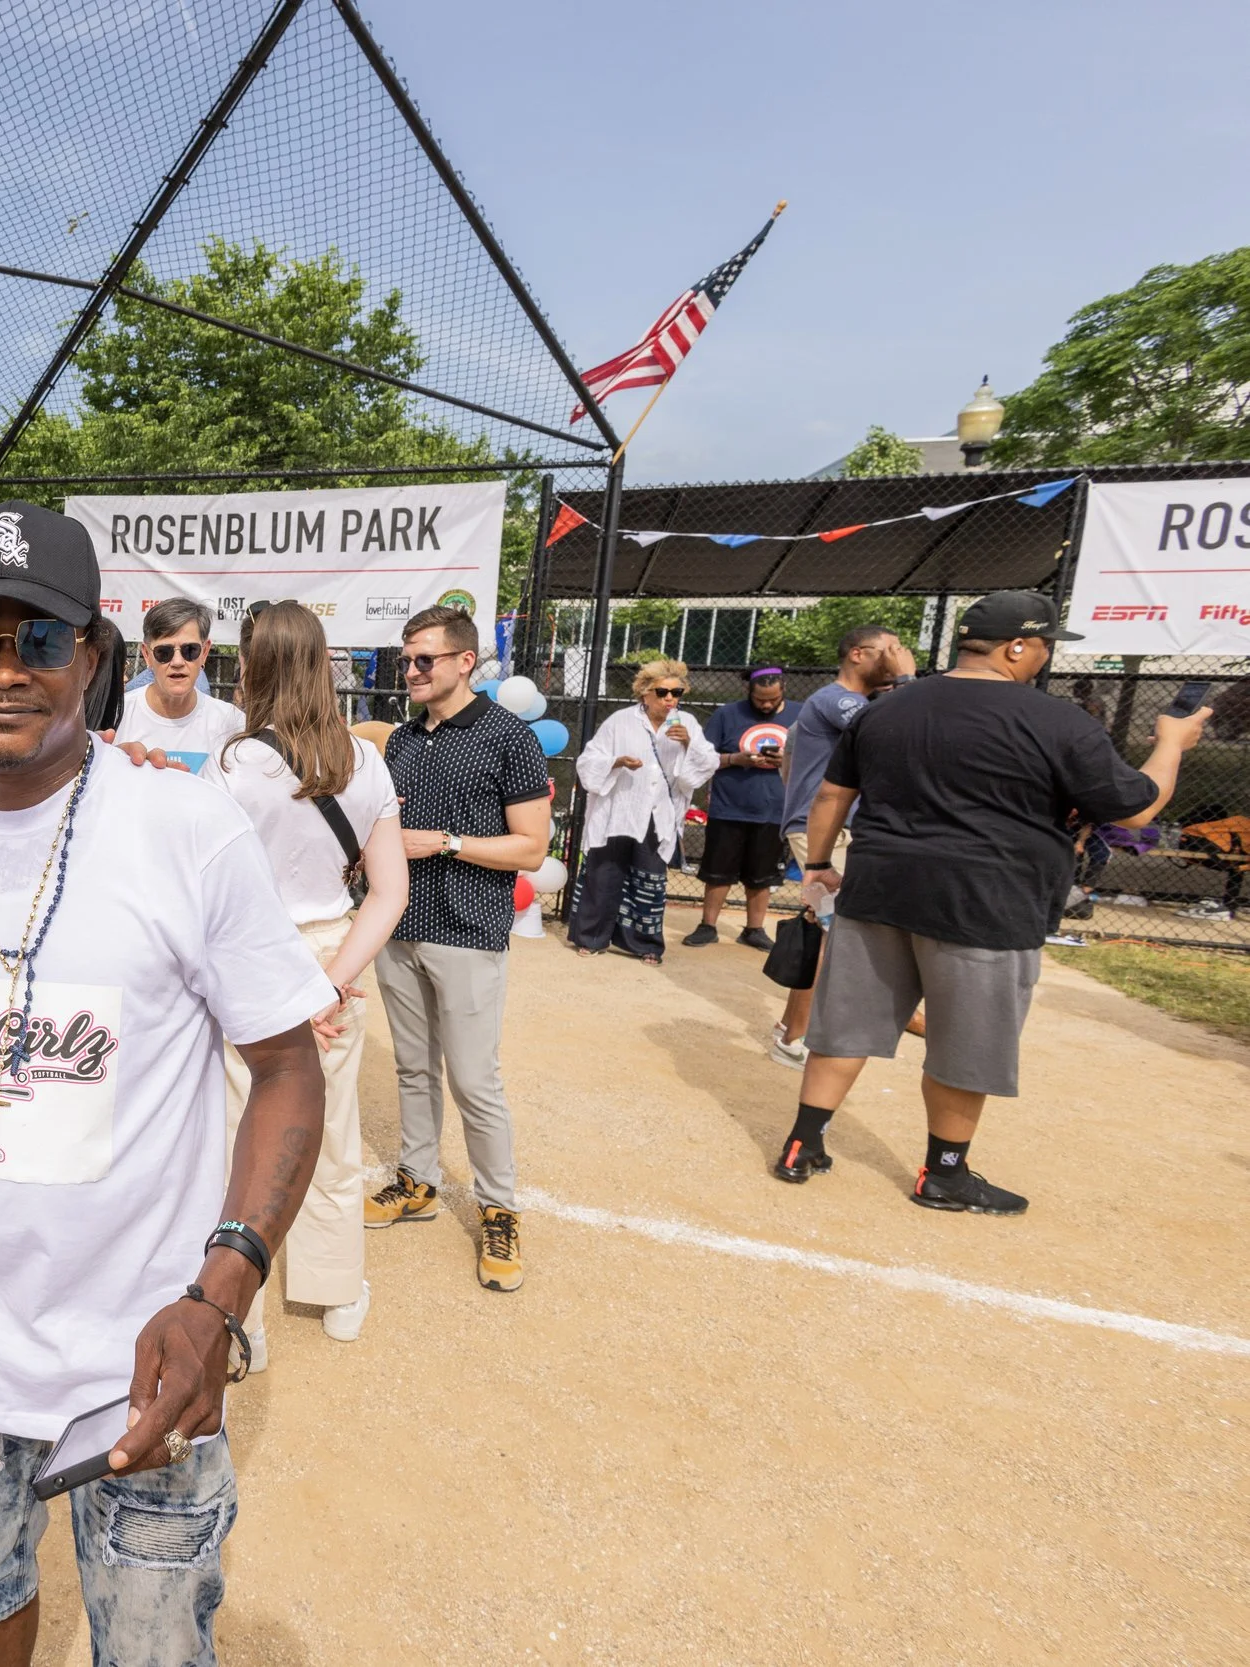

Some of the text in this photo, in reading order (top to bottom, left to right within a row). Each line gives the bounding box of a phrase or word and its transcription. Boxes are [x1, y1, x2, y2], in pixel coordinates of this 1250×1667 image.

[111, 506, 442, 556] ROSENBLUM PARK
[218, 597, 246, 609] LOST
[366, 603, 382, 615] love
[1091, 605, 1168, 621] ESPN
[33, 1071, 67, 1079] SOFTBALL
